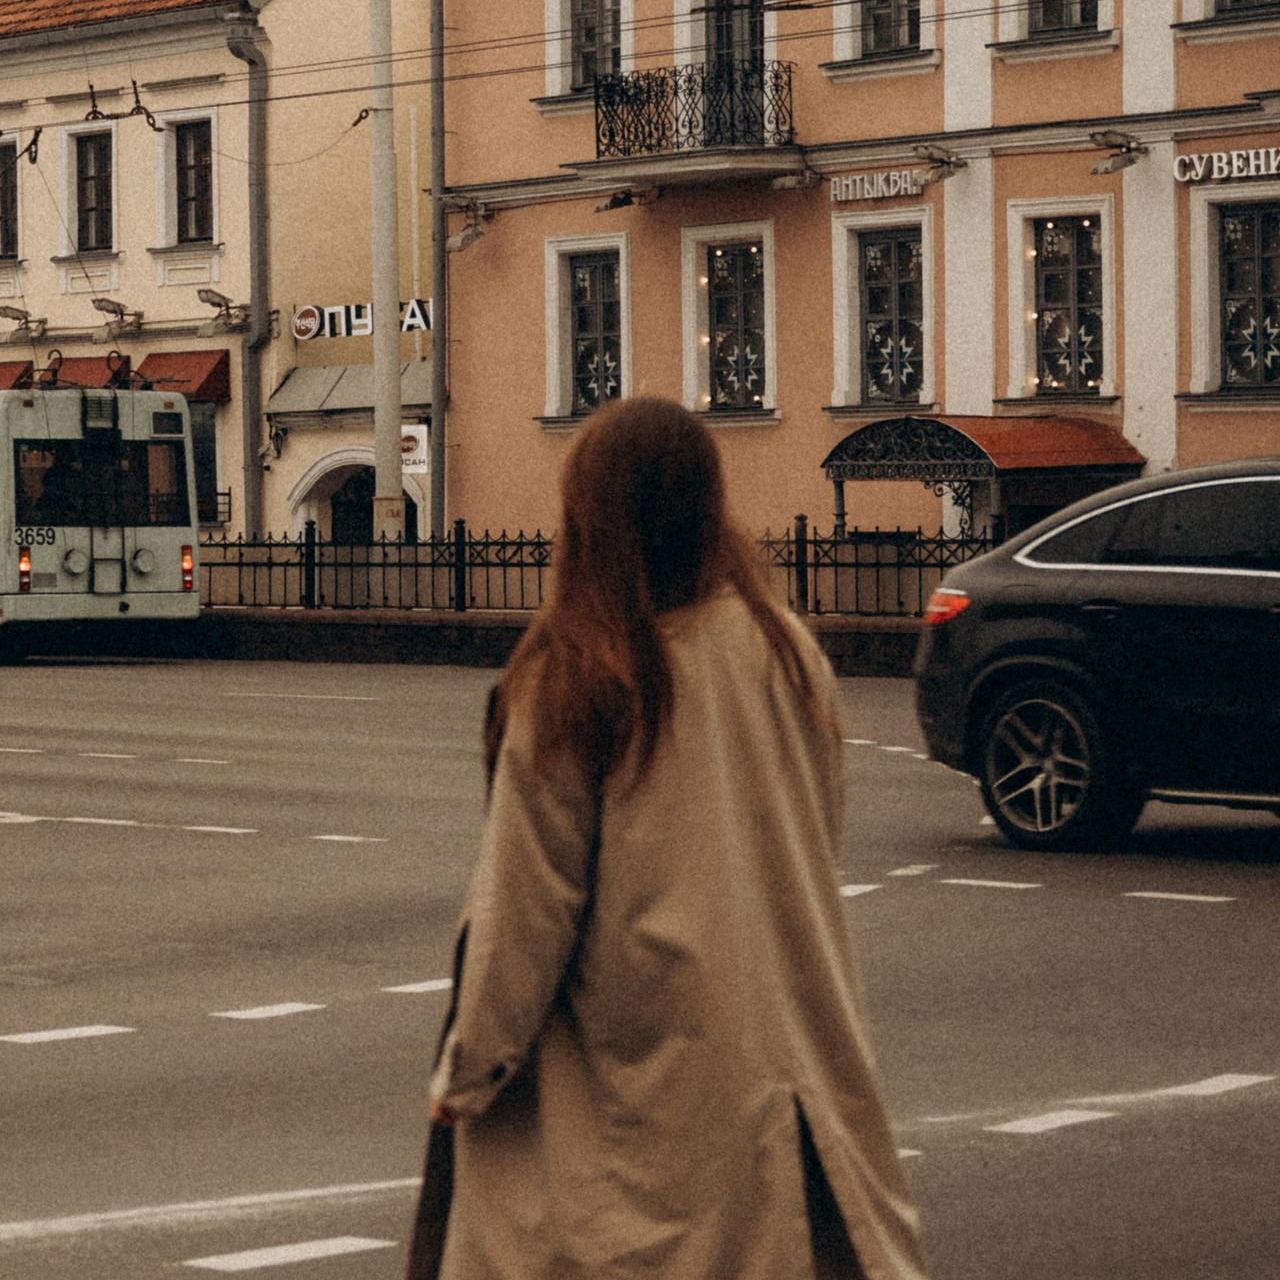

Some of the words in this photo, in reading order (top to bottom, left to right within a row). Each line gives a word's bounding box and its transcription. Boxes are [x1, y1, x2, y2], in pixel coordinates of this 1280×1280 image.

[324, 298, 433, 338] ПУА
[402, 458, 426, 466] САН
[15, 527, 56, 546] 3659
